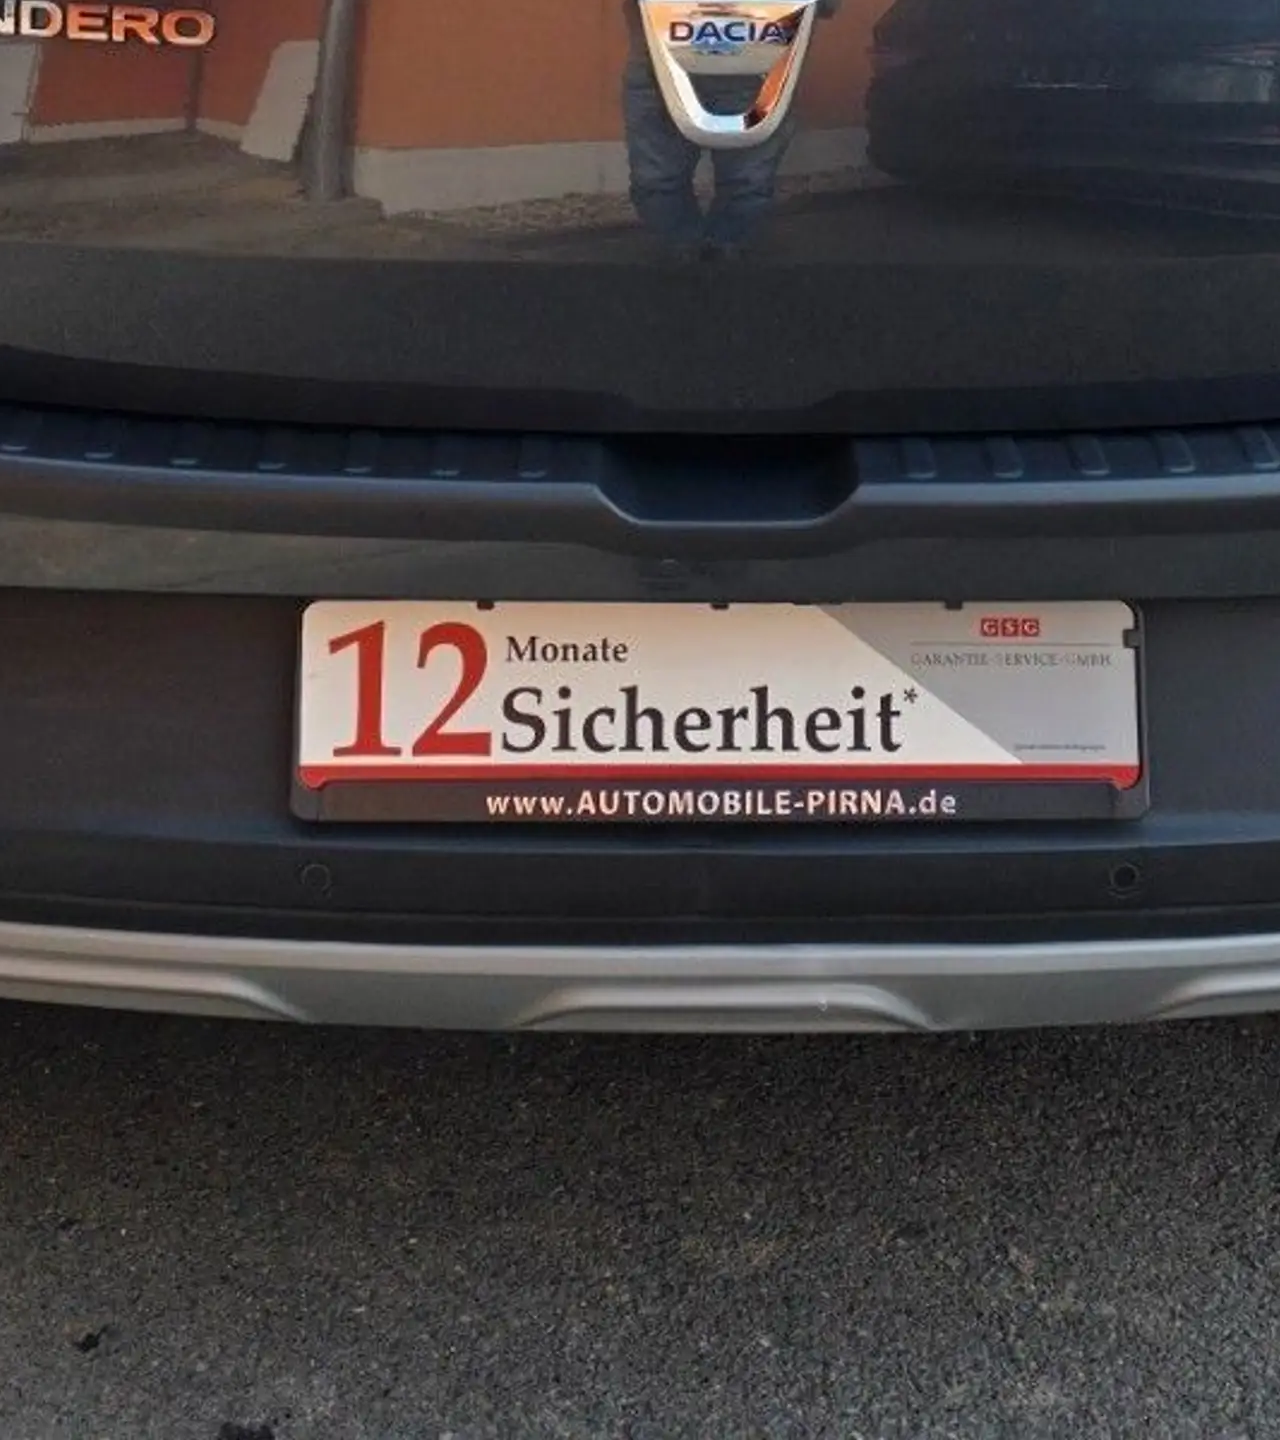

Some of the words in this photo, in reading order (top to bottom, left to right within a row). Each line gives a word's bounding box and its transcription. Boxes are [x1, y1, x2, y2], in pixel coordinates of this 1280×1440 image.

[670, 21, 787, 42] DACIA
[980, 617, 1041, 638] GSG
[505, 635, 629, 663] Monate
[328, 620, 492, 757] 12
[486, 789, 957, 817] www.AUTOMOBILE-PIRNA.de
